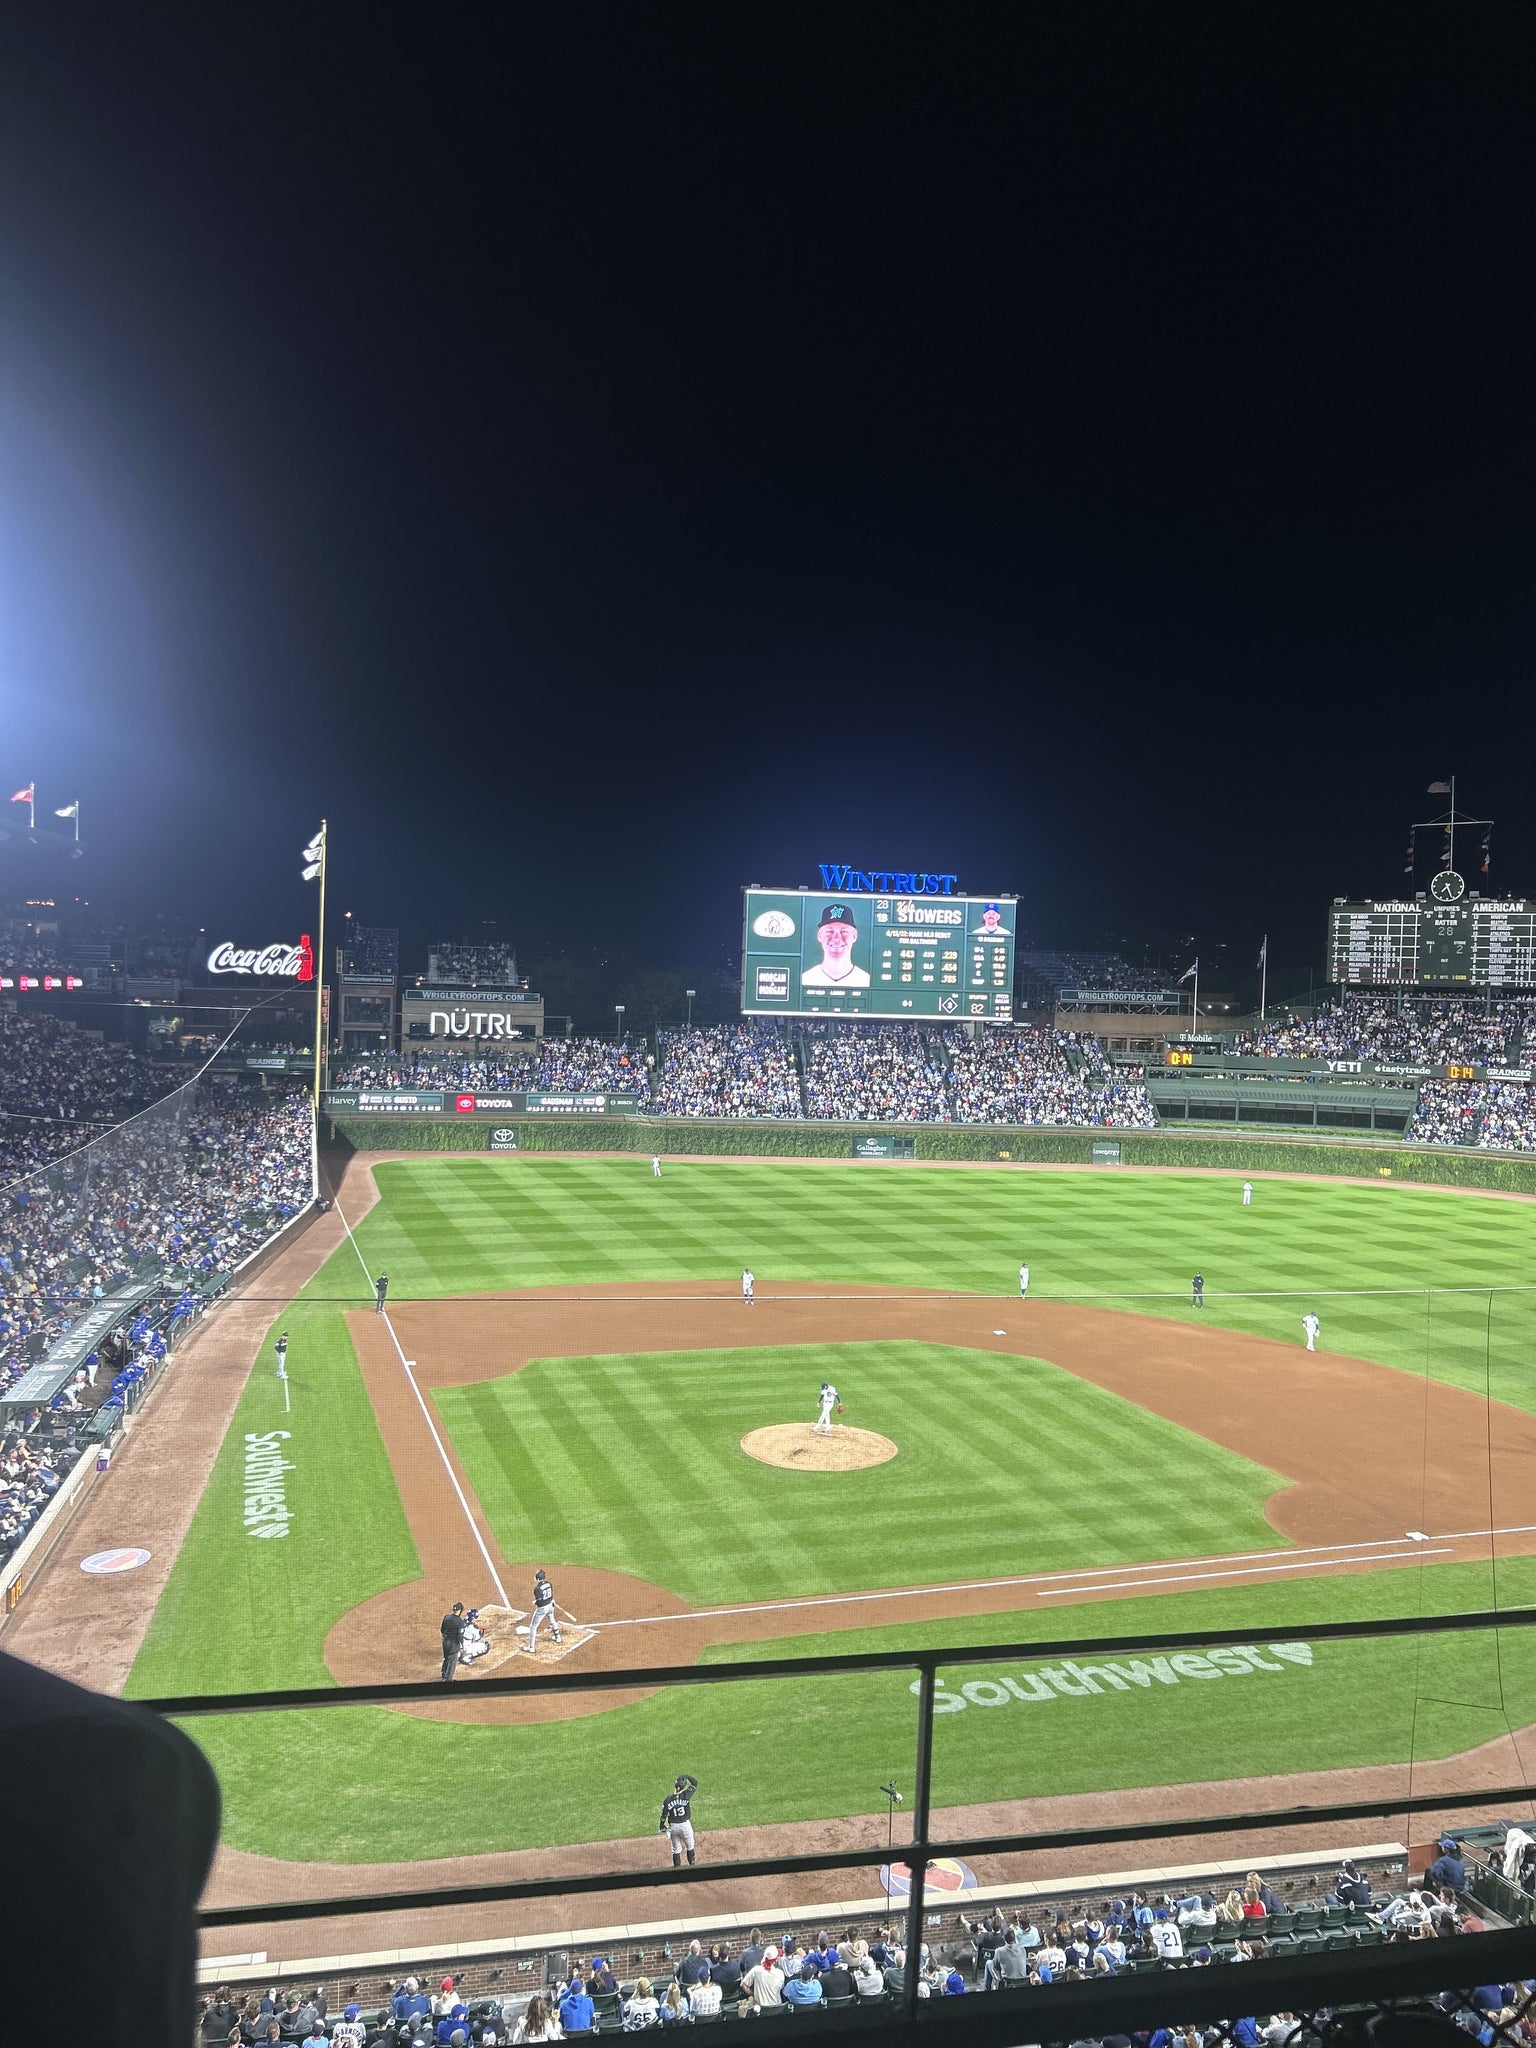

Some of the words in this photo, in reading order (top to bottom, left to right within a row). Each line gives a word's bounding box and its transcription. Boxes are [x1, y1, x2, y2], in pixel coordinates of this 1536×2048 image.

[818, 864, 957, 895] WINTRUST
[877, 900, 888, 909] 28
[1374, 903, 1421, 912] NATIONAL
[1472, 903, 1524, 912] AMERICAN
[898, 909, 962, 924] STOWERS
[1438, 927, 1454, 936] 28
[1429, 945, 1432, 954] 1
[1456, 945, 1463, 954] 2
[207, 942, 306, 975] Coca-Cola
[422, 991, 525, 1001] WRIGLEYROOFTOPS.COM
[1078, 992, 1163, 1001] WRIGLEYROOFTOPS.COM
[971, 1004, 984, 1014] 82
[1327, 1061, 1362, 1072] YETI
[1382, 1064, 1431, 1075] tastytrade
[1450, 1066, 1473, 1078] 0:14
[1486, 1068, 1531, 1077] GRAINGER
[328, 1096, 356, 1106] Harvey
[476, 1100, 513, 1108] TOYOTA
[243, 1430, 296, 1526] Southwest
[909, 1644, 1285, 1714] Southwest
[673, 1807, 685, 1817] 13
[1162, 1932, 1179, 1947] 21
